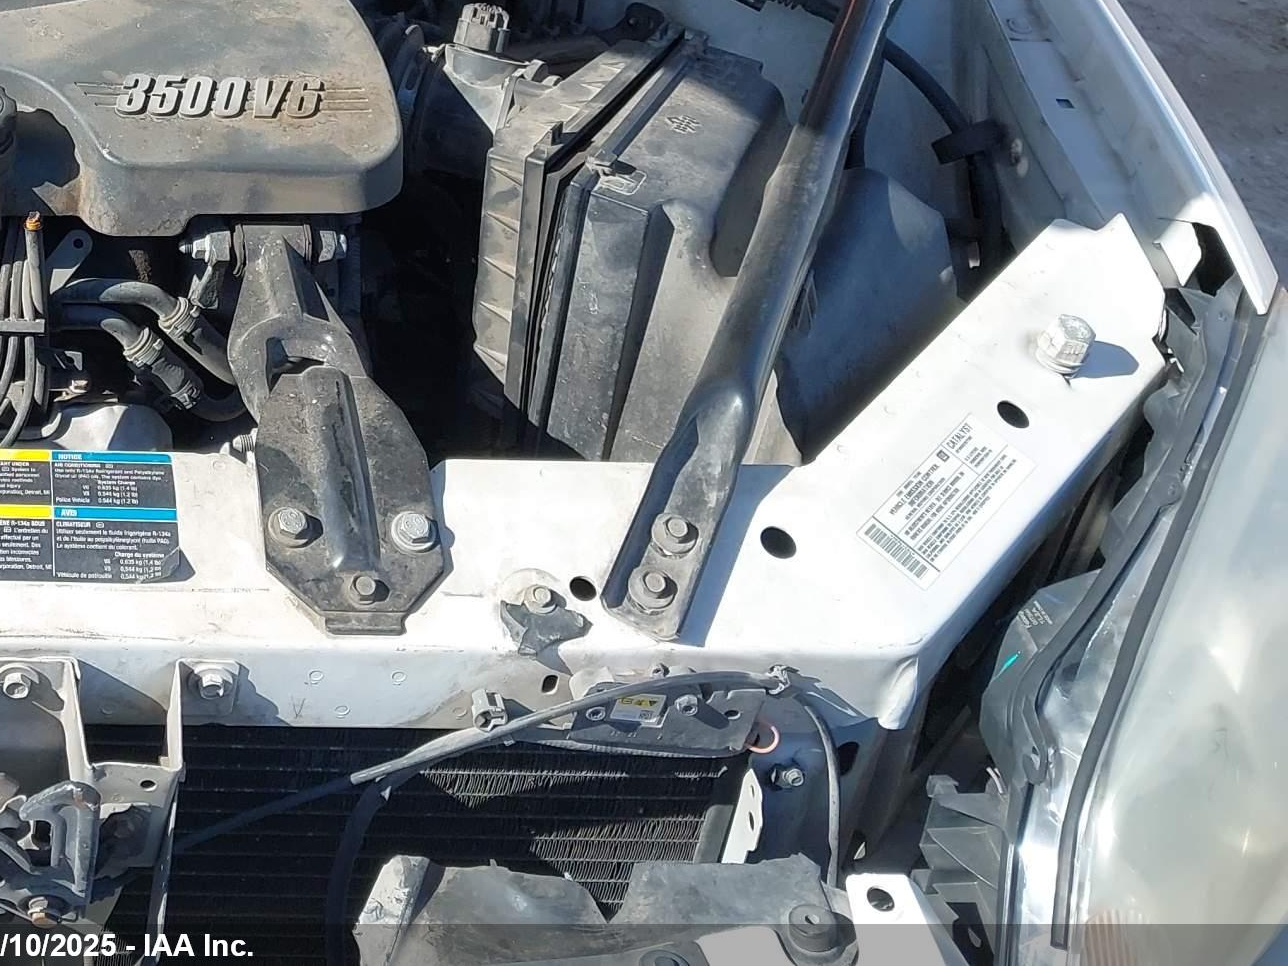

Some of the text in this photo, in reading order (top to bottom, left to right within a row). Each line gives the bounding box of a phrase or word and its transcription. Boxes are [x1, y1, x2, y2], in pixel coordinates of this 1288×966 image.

[115, 73, 326, 120] 3500 V6
[945, 422, 973, 449] CATALYST
